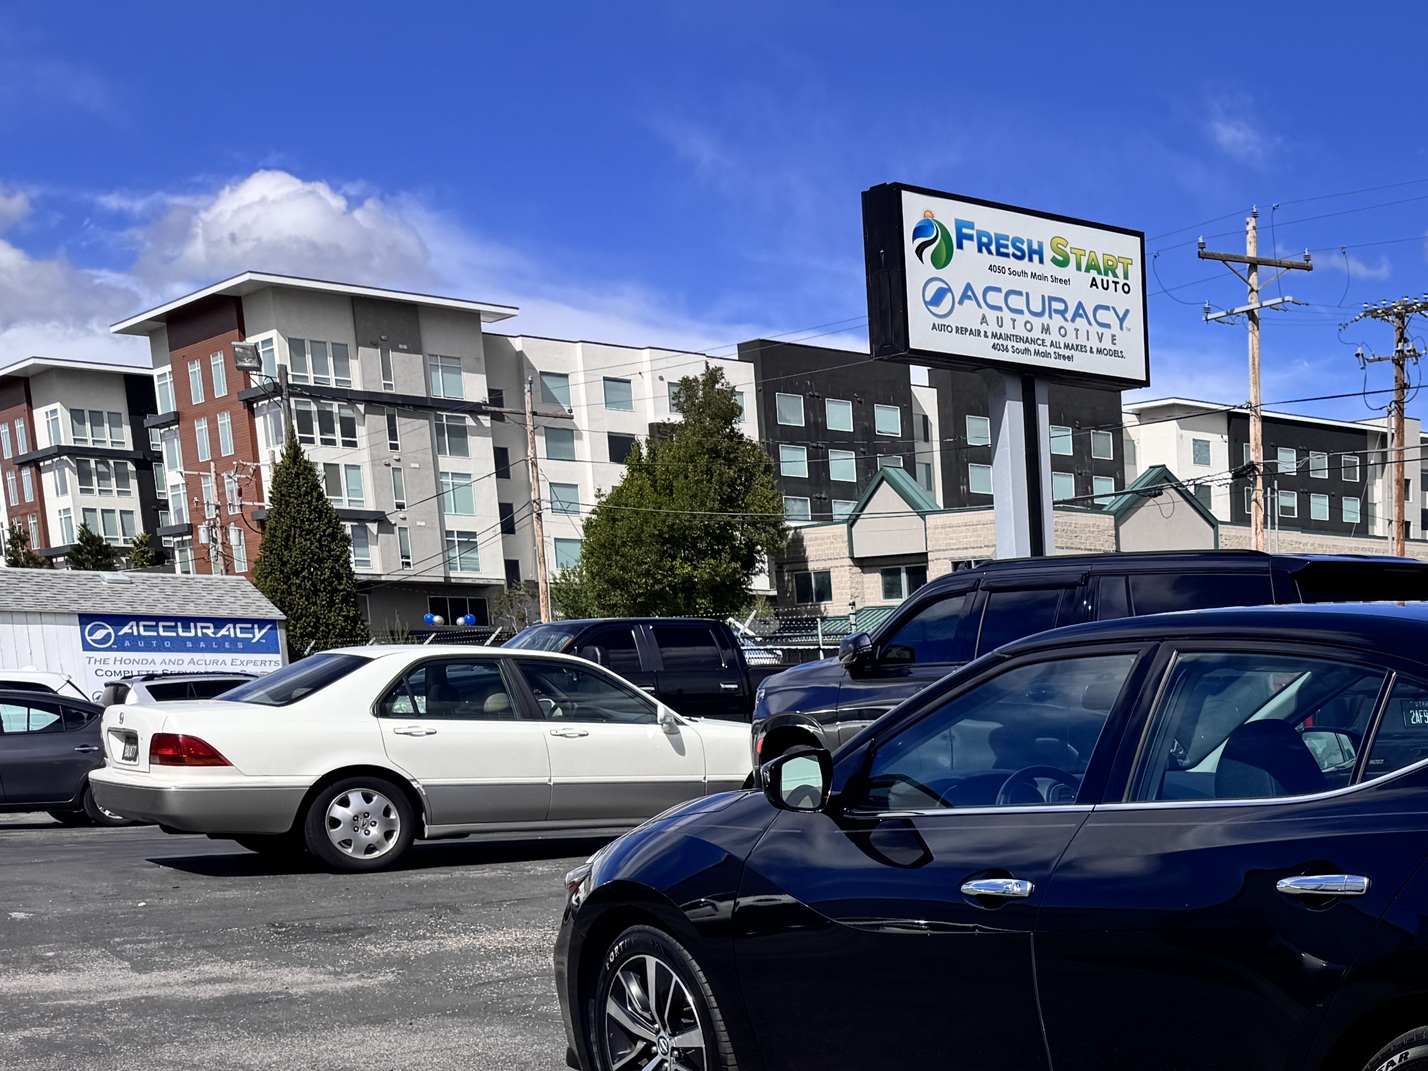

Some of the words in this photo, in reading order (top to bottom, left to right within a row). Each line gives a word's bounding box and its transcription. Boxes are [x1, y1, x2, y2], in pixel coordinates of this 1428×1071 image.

[954, 218, 1044, 265] FRESH
[1050, 236, 1133, 281] START
[988, 264, 1006, 275] 4050
[1007, 267, 1029, 279] South
[1030, 271, 1049, 282] Main
[1050, 274, 1071, 286] Street
[1090, 276, 1131, 294] AUTO
[957, 281, 1130, 331] ACCURACY
[979, 313, 1117, 345] AUTOMOTIVE
[931, 322, 953, 333] AUTO
[955, 326, 982, 338] REPAIR
[983, 329, 989, 339] &
[1049, 339, 1062, 350] ALL
[1063, 341, 1088, 354] MAKES
[1089, 345, 1094, 355] &
[1096, 347, 1126, 360] MODELS.
[991, 341, 1010, 353] 4036
[1011, 345, 1032, 356] South
[1033, 348, 1051, 359] Main
[1053, 351, 1074, 363] Street
[117, 621, 272, 643] ACCURACY
[124, 640, 171, 648] AUTO
[186, 641, 244, 649] SALES
[86, 656, 110, 665] THE
[113, 657, 156, 666] HONDA
[160, 658, 185, 666] AND
[187, 657, 227, 667] ACURA
[230, 658, 280, 667] EXPERTS
